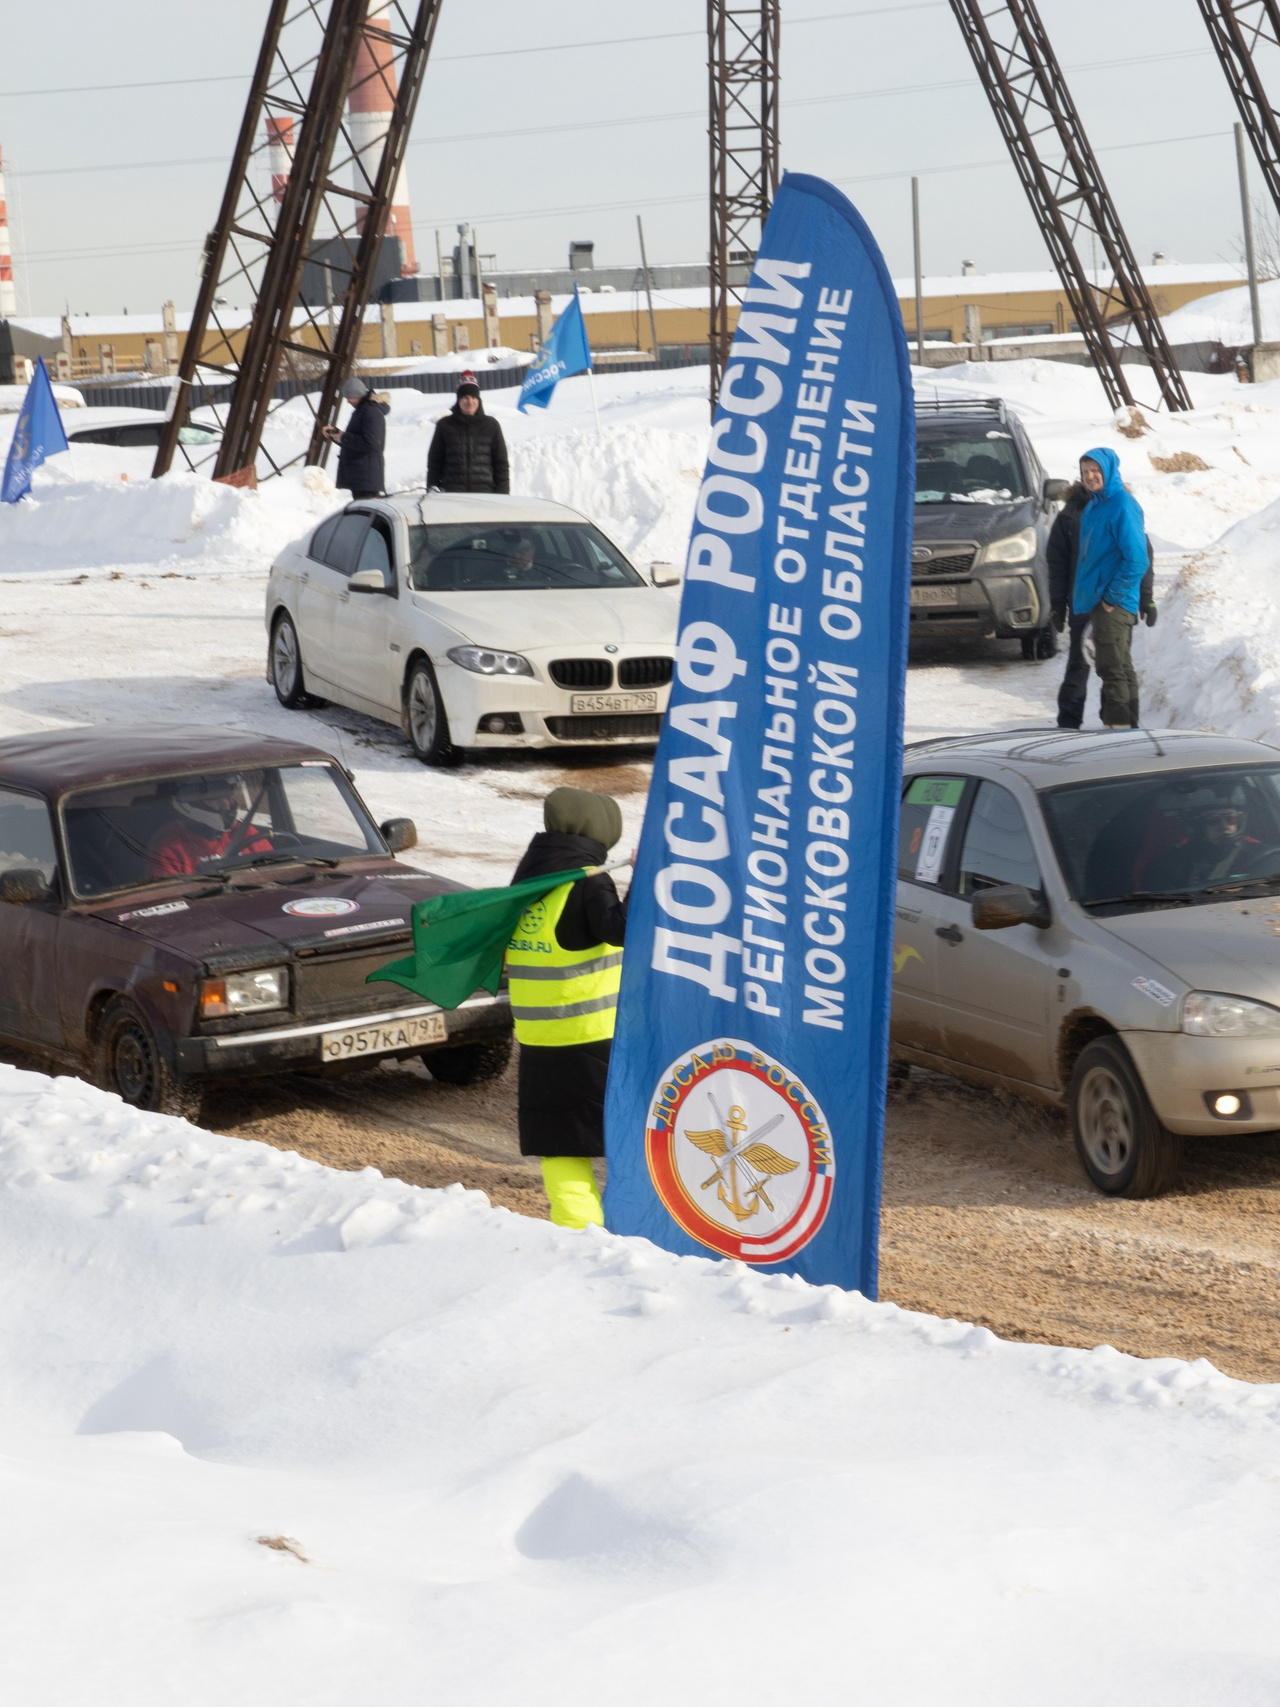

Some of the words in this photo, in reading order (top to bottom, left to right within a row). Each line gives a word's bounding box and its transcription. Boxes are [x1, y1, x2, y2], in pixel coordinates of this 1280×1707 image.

[685, 258, 812, 593] РОССИИ
[819, 399, 878, 641] ОБЛАСТИ
[651, 620, 748, 1002] ДОСААФ
[741, 602, 803, 1017] РЕГИОНАЛЬНОЕ
[773, 287, 853, 584] ОТДЕЛЕНИЕ
[802, 659, 859, 1031] МОСКОВСКОЙ
[328, 1028, 408, 1057] О957КА
[409, 1016, 439, 1037] 797
[750, 1051, 832, 1166] РОССИИ
